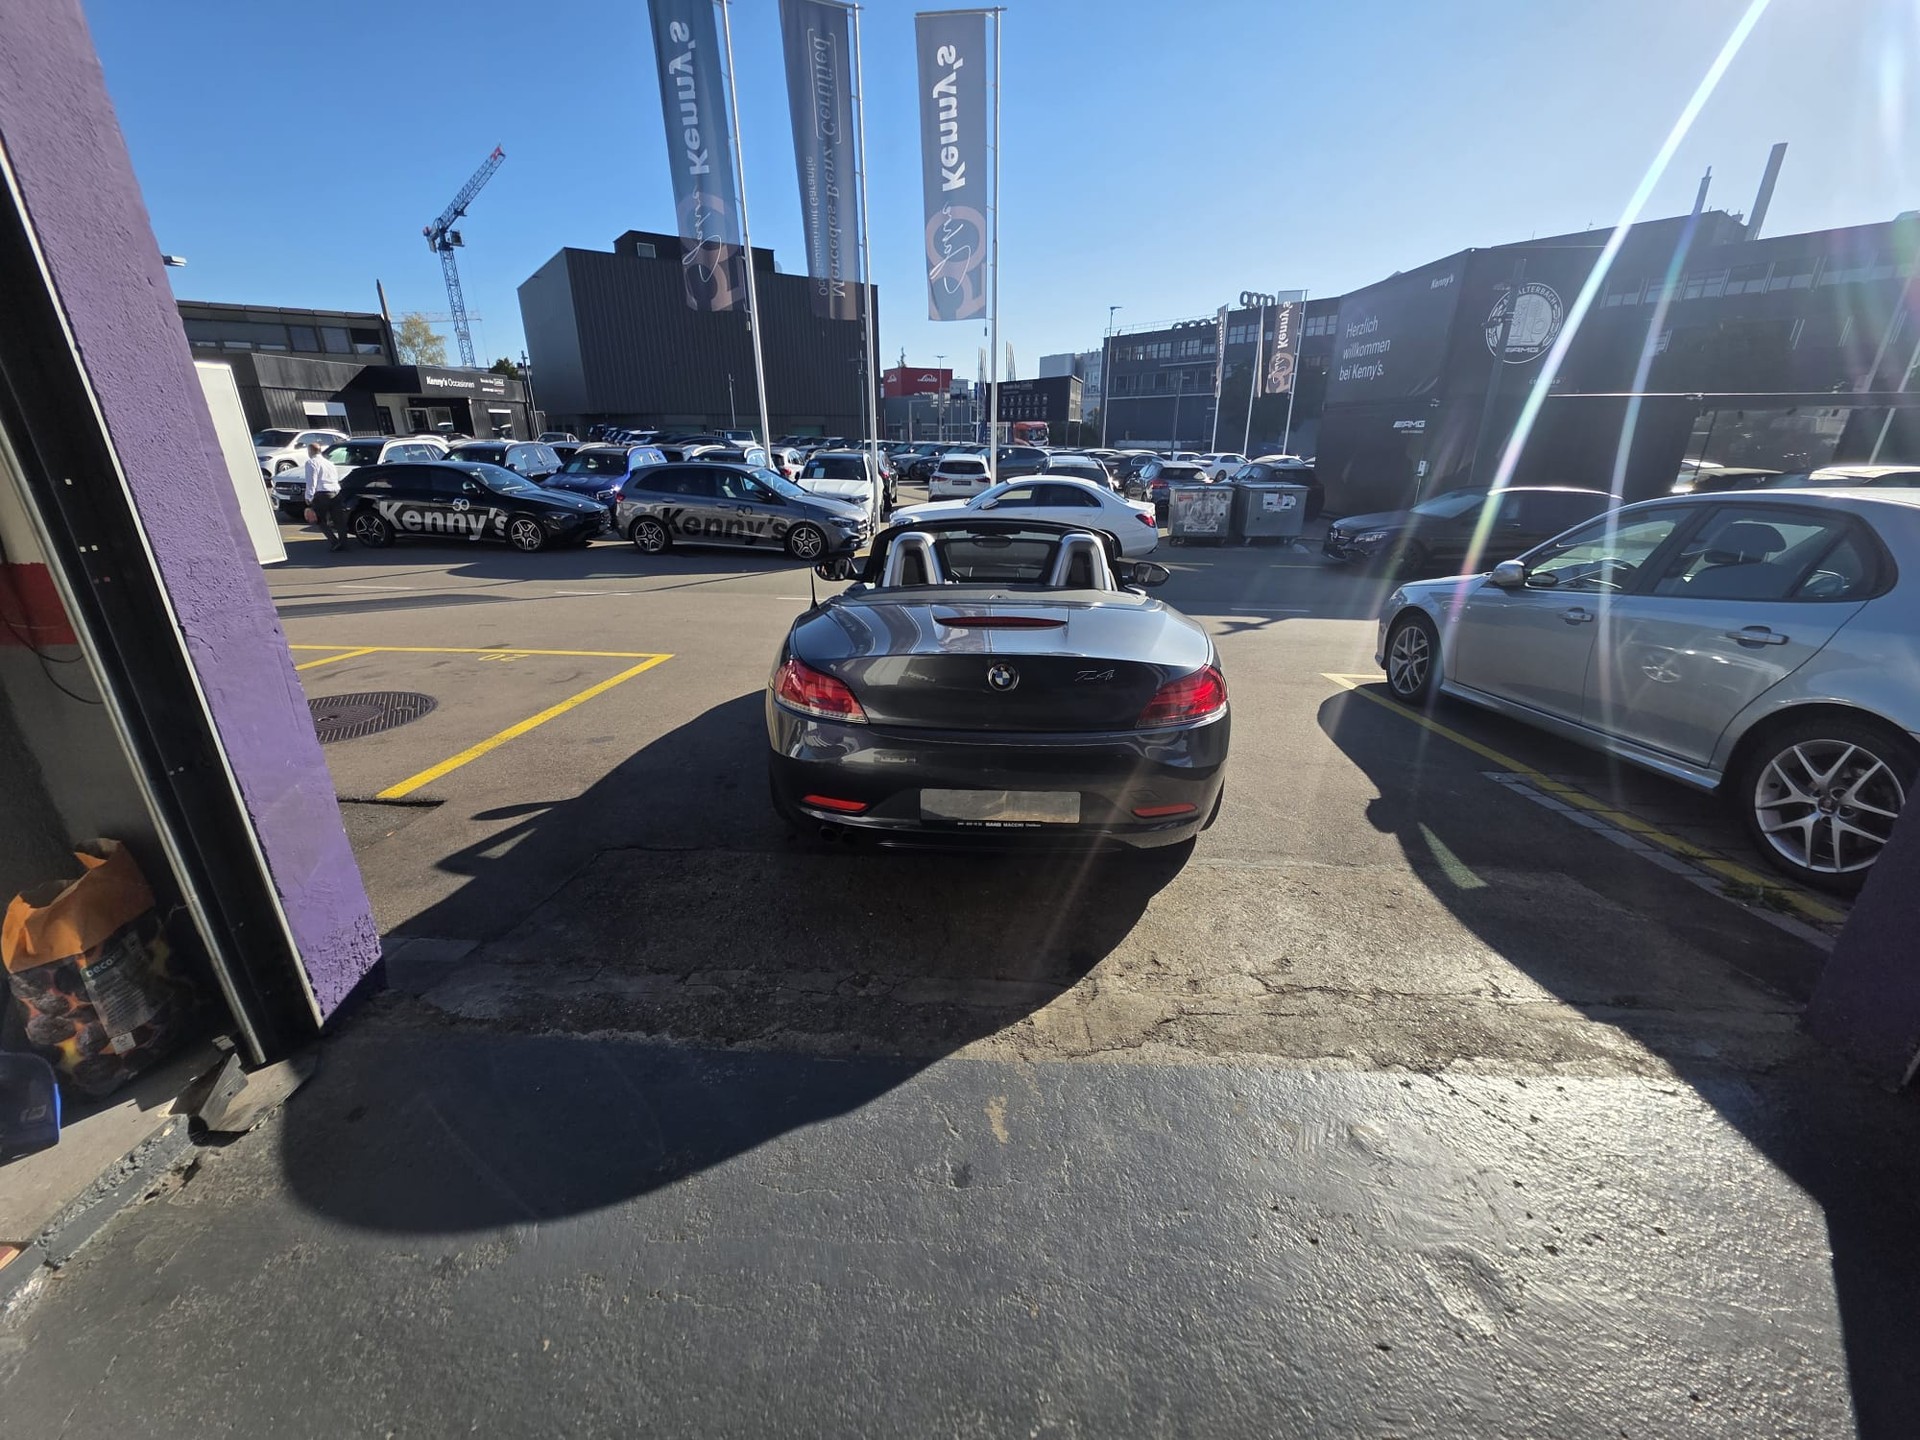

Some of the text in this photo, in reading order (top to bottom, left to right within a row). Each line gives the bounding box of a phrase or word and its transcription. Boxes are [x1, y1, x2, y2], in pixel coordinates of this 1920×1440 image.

[1346, 315, 1378, 338] Herzlich
[1343, 339, 1391, 360] willkommen
[1339, 366, 1351, 381] bei
[426, 376, 447, 388] Kenny's
[452, 498, 470, 511] 50
[737, 504, 753, 517] 50
[379, 501, 507, 541] Kenny's
[663, 508, 788, 545] Kenny's
[1074, 669, 1115, 682] Z4
